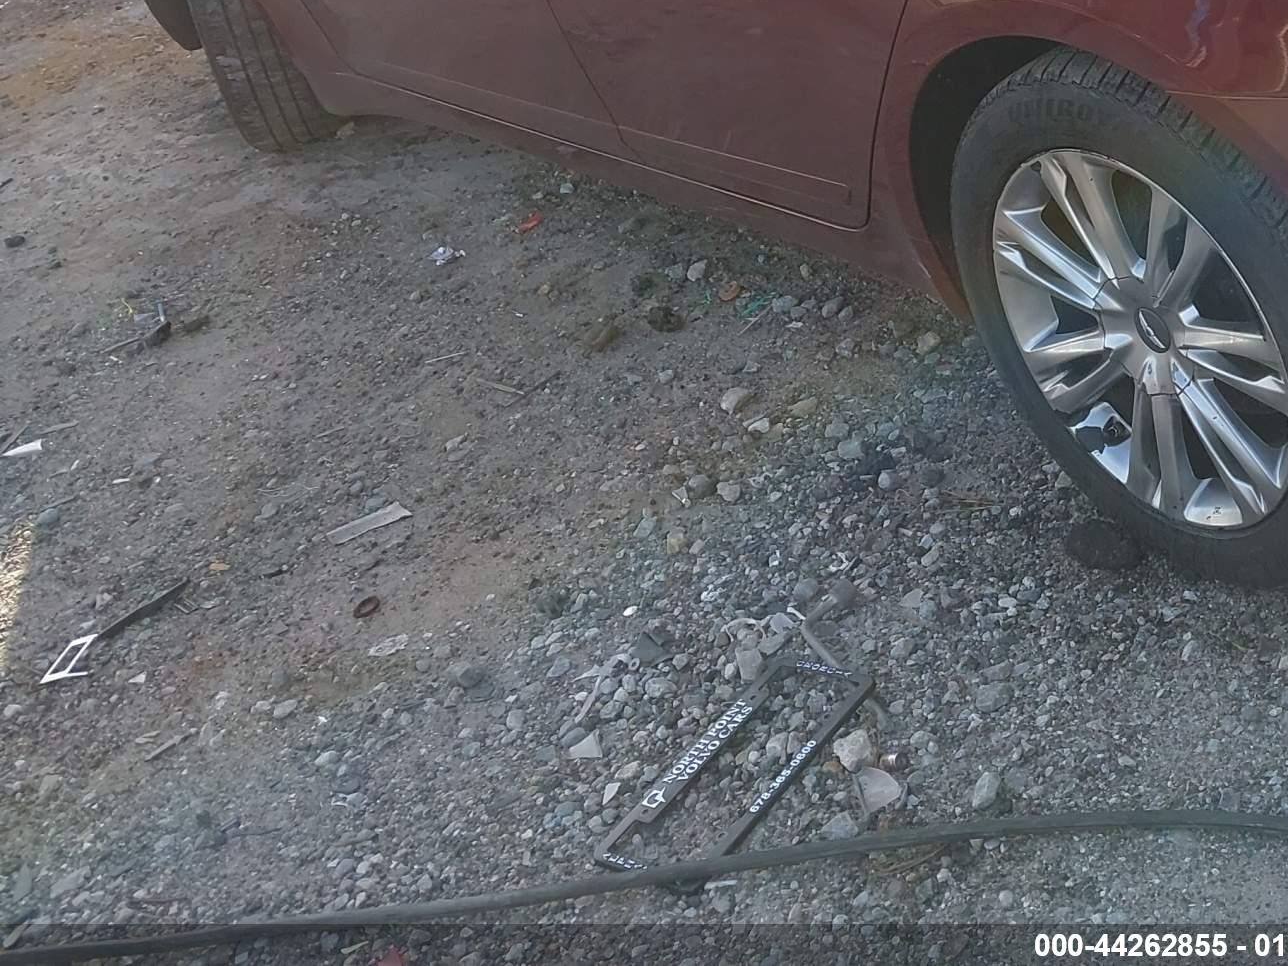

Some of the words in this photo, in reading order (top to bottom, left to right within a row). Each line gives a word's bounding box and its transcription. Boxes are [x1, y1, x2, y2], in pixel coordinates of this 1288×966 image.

[662, 739, 710, 784] NORTH
[707, 698, 746, 737] POINT
[676, 740, 720, 781] VOLVO
[719, 706, 753, 739] CARS
